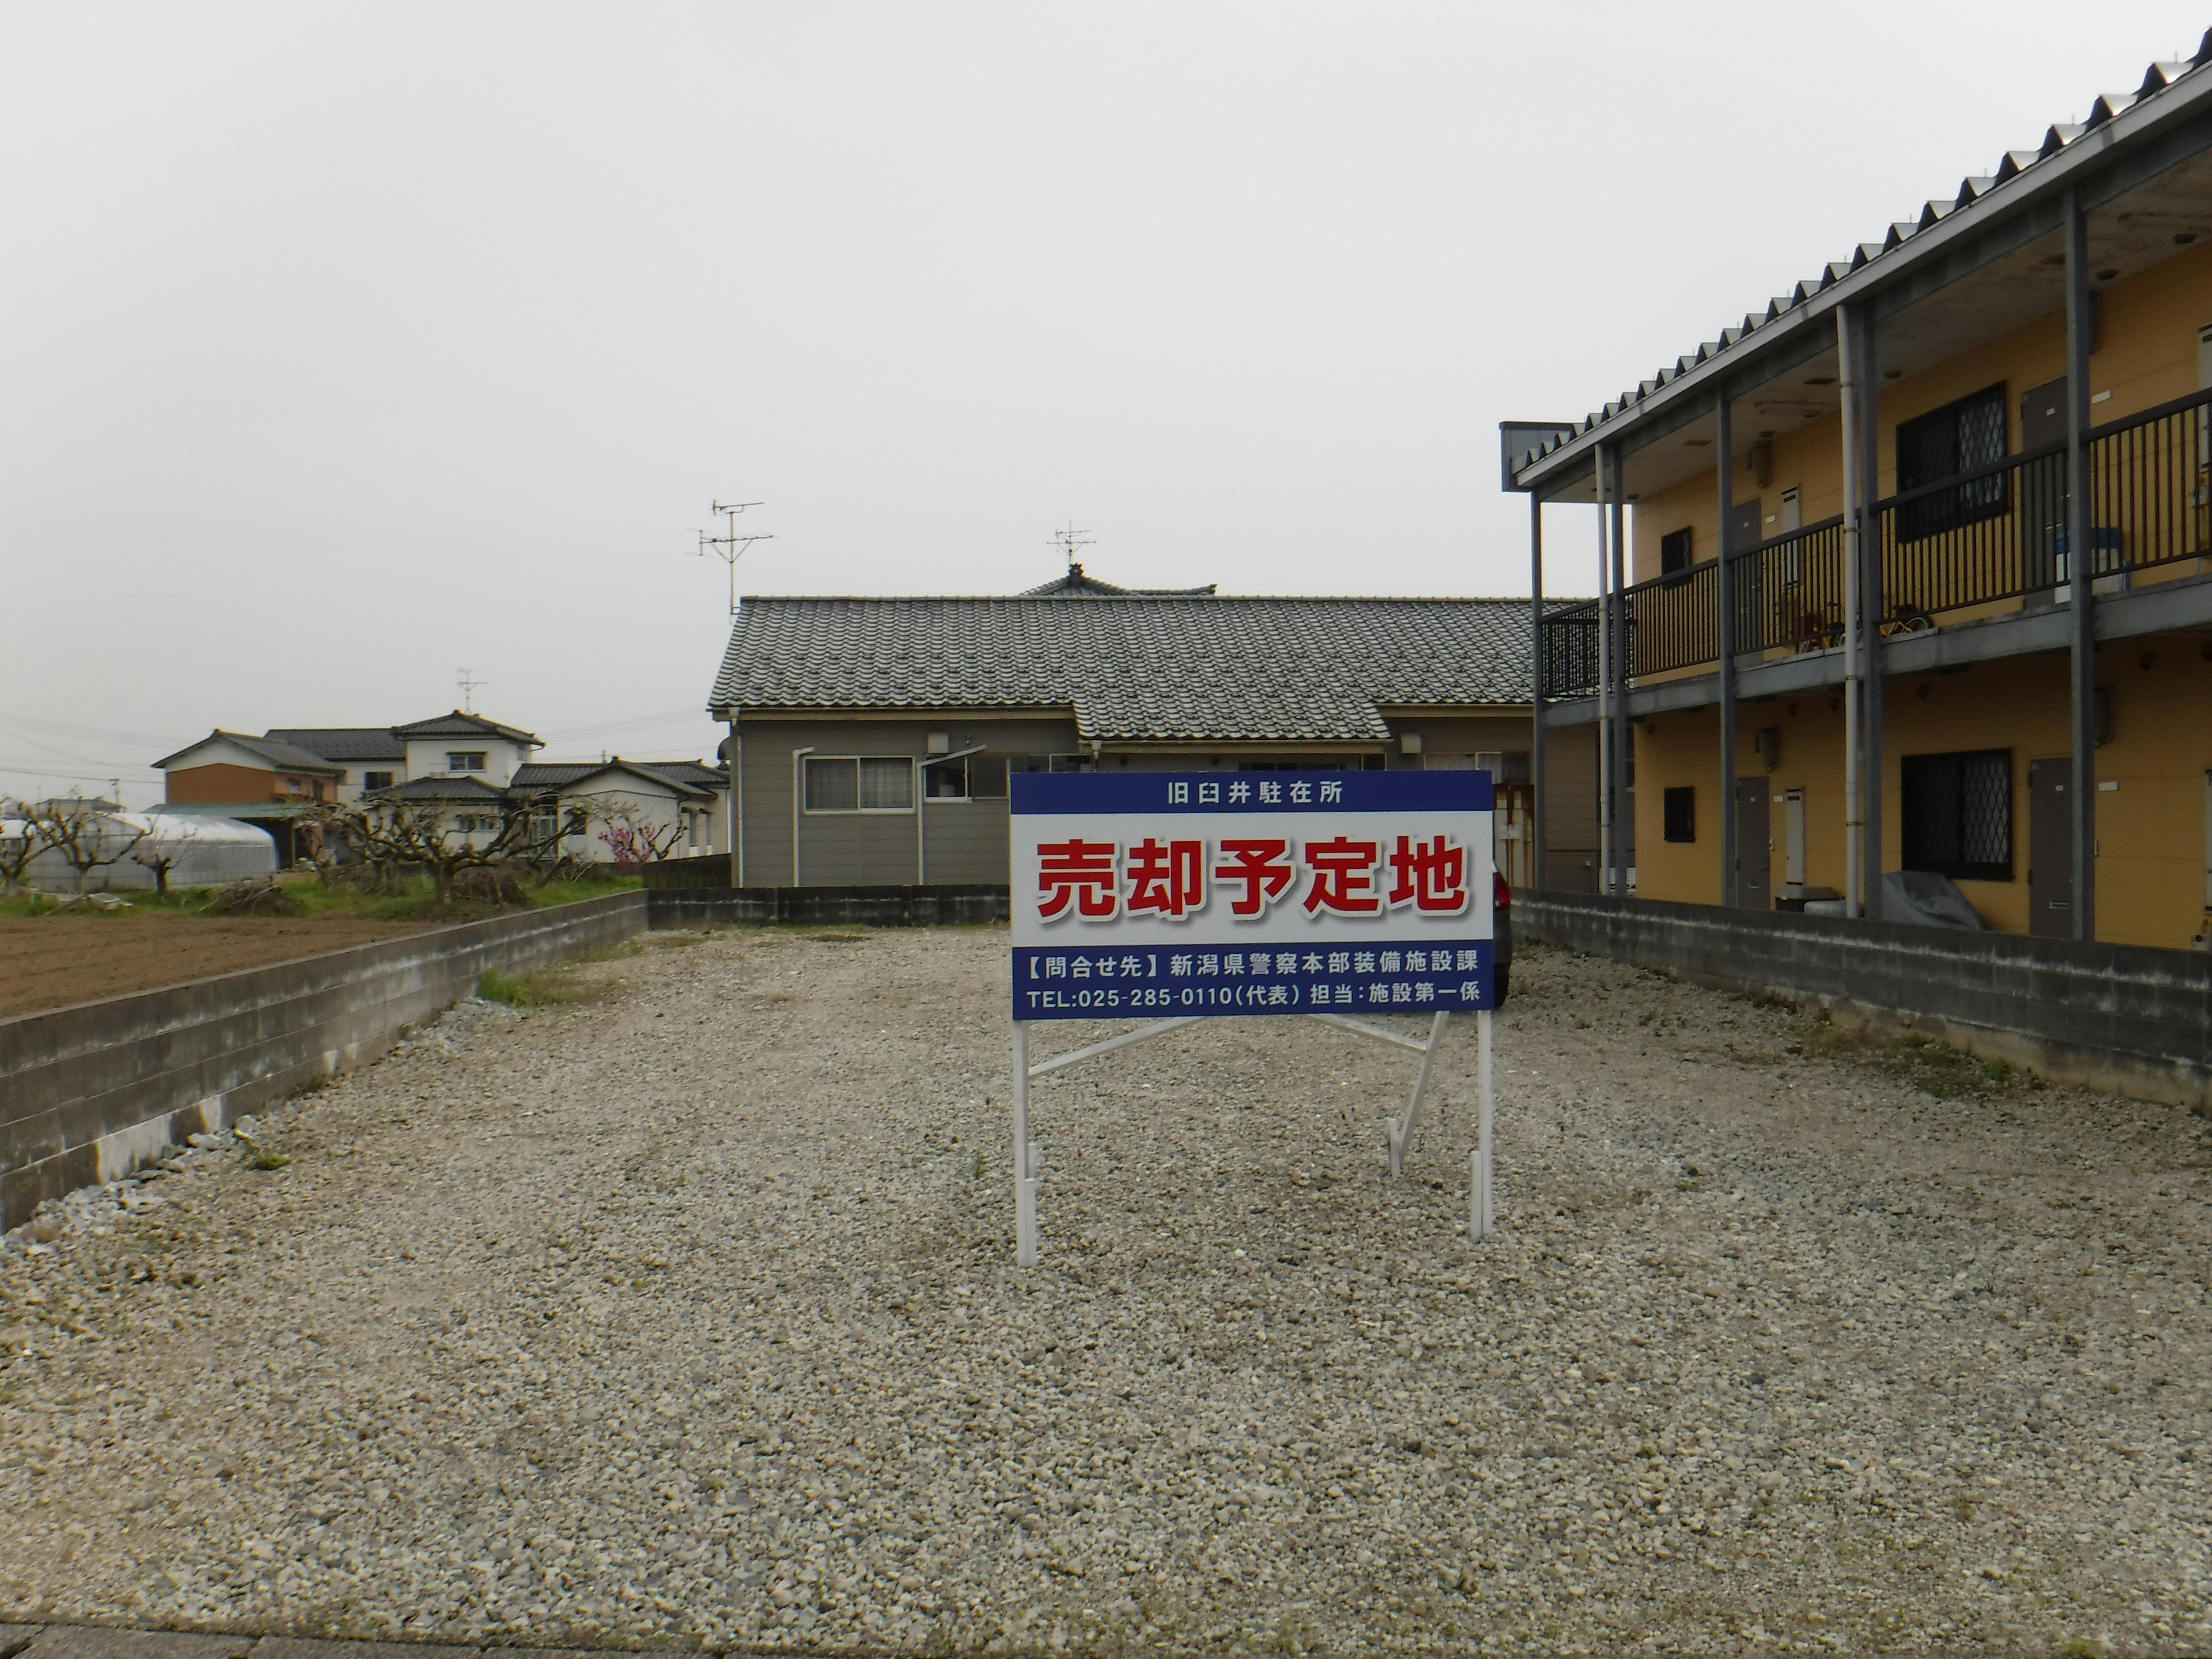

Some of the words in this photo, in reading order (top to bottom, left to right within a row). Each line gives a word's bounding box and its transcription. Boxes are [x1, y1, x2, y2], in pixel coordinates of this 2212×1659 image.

[1168, 780, 1342, 805] 旧臼井駐在所
[1036, 835, 1465, 918] 売却予定地
